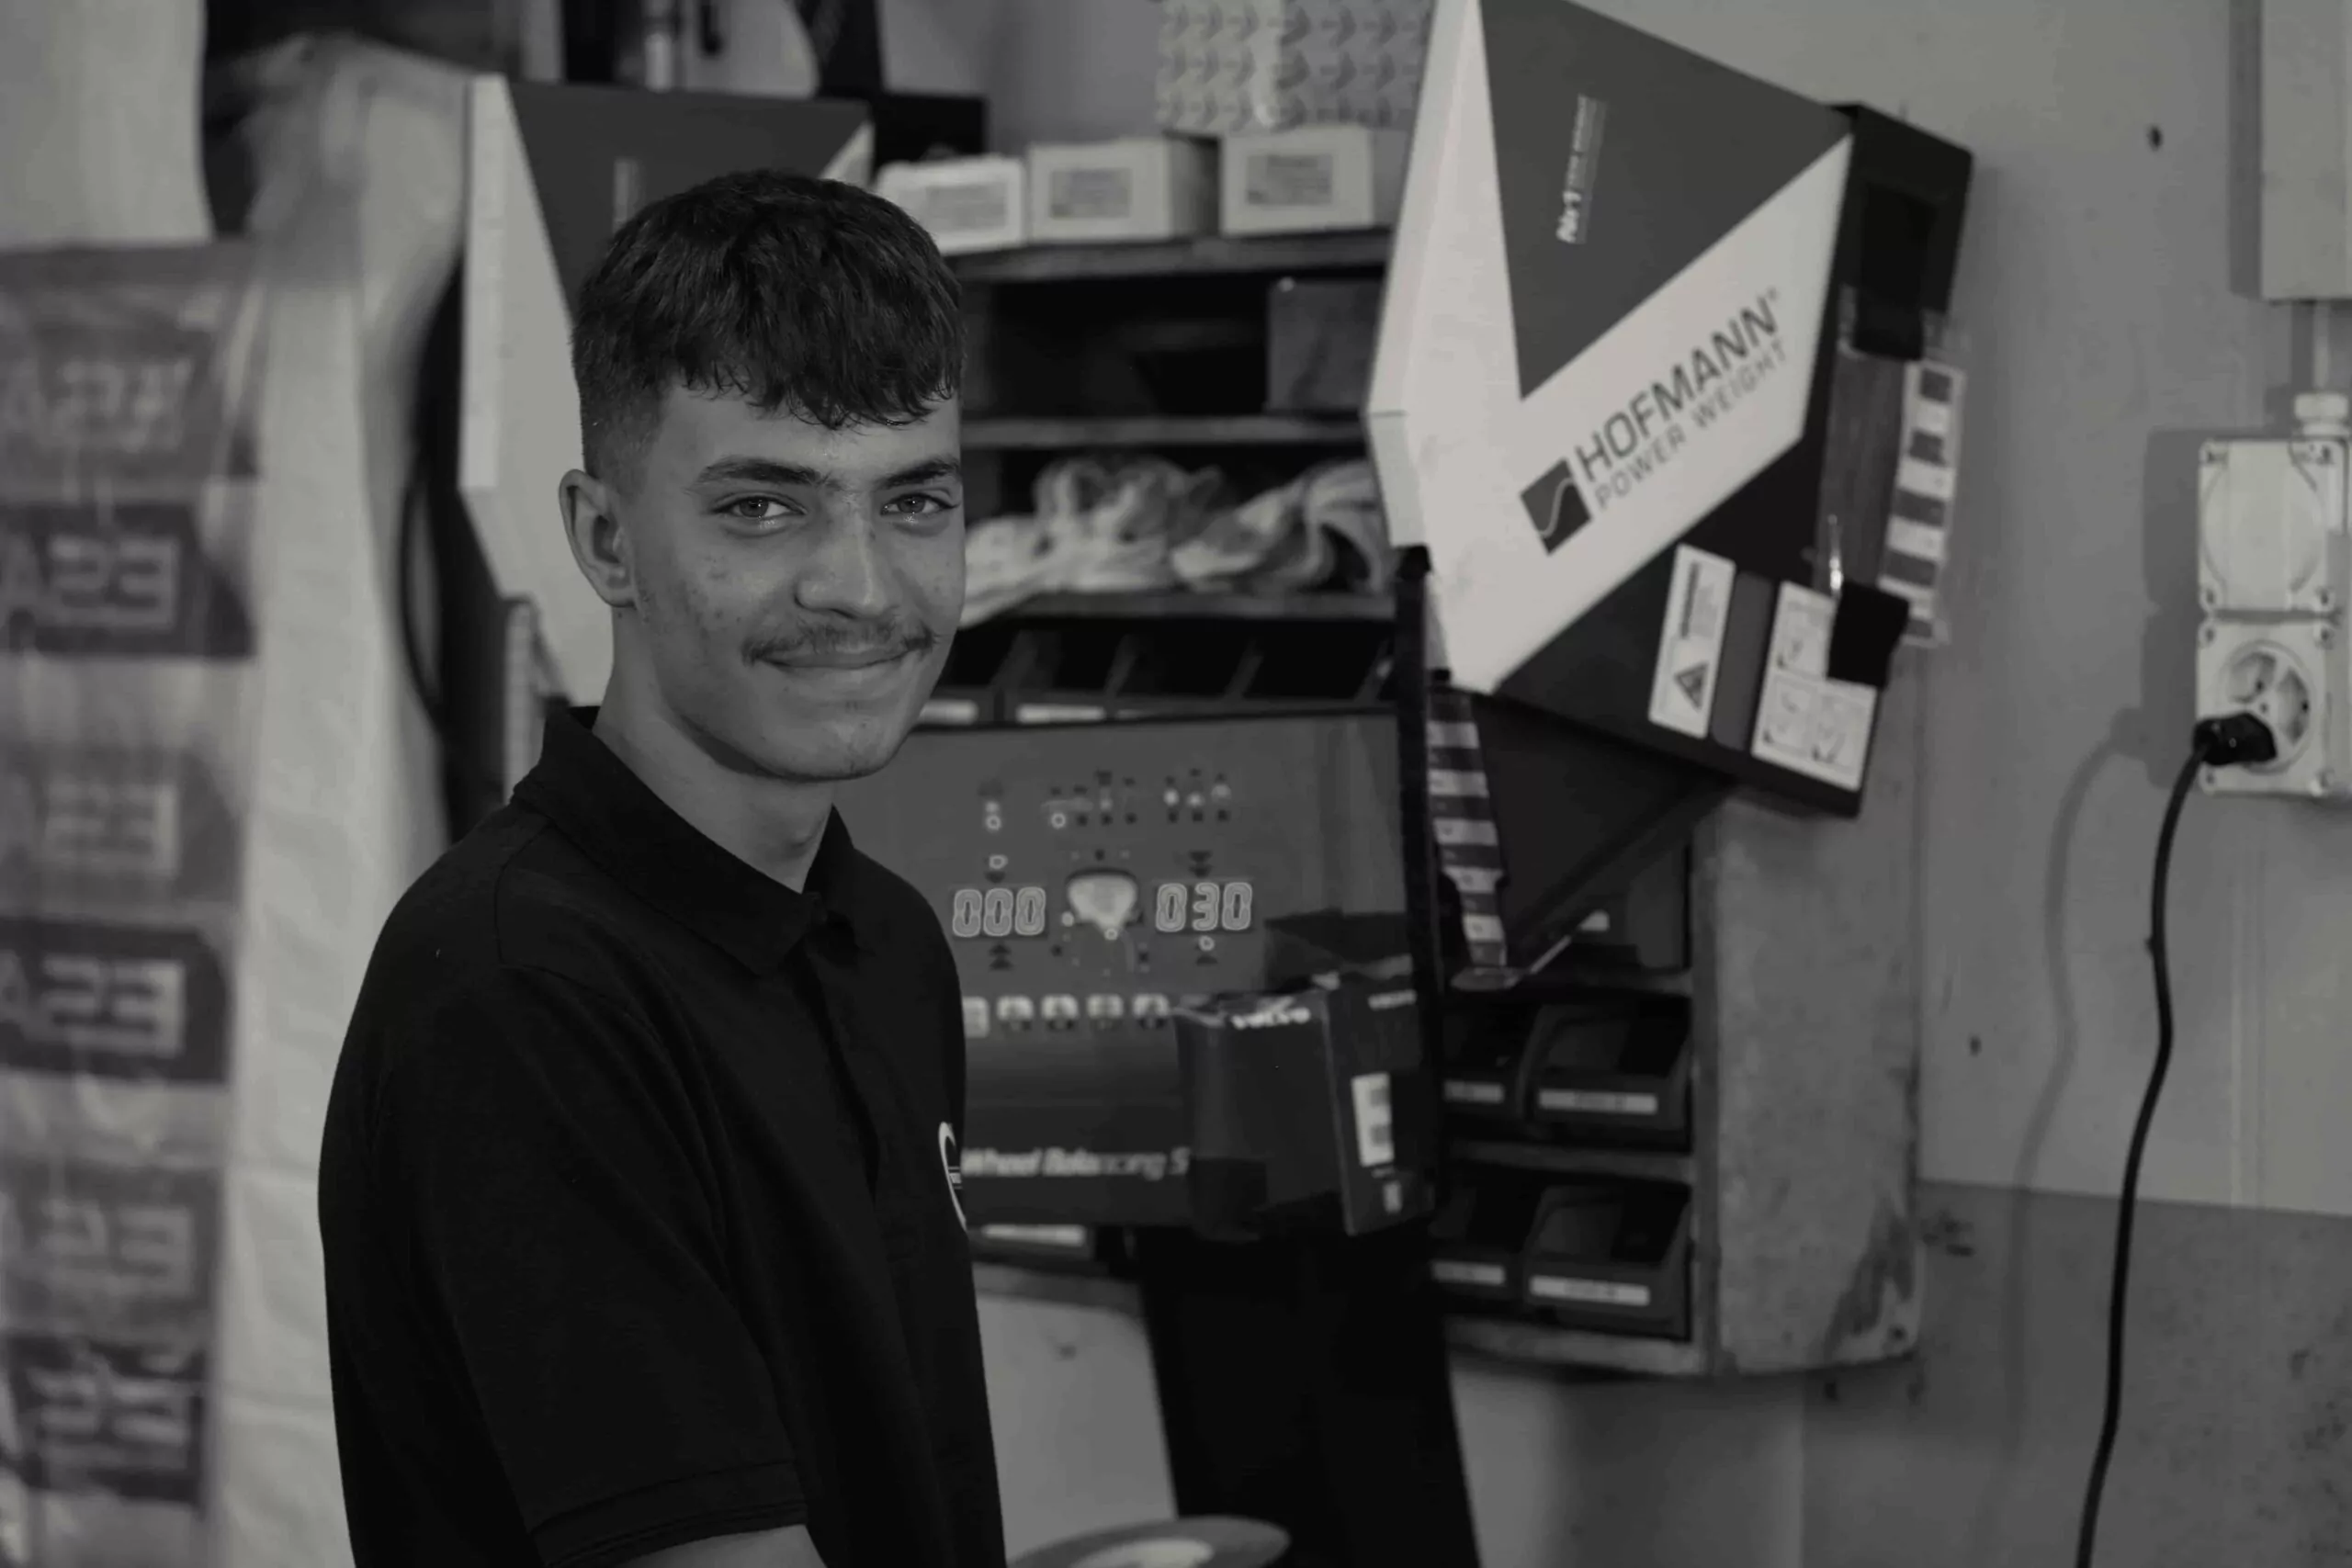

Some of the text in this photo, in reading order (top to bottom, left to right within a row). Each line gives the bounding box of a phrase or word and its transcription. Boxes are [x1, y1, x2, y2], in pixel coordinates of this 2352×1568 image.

[1575, 294, 1777, 483] HOFMANN
[1594, 338, 1786, 510] POWER WEIGHT
[953, 886, 1047, 938] 000
[1156, 882, 1253, 933] 030
[1043, 1145, 1167, 1182] Balancing
[1169, 1145, 1193, 1177] S
